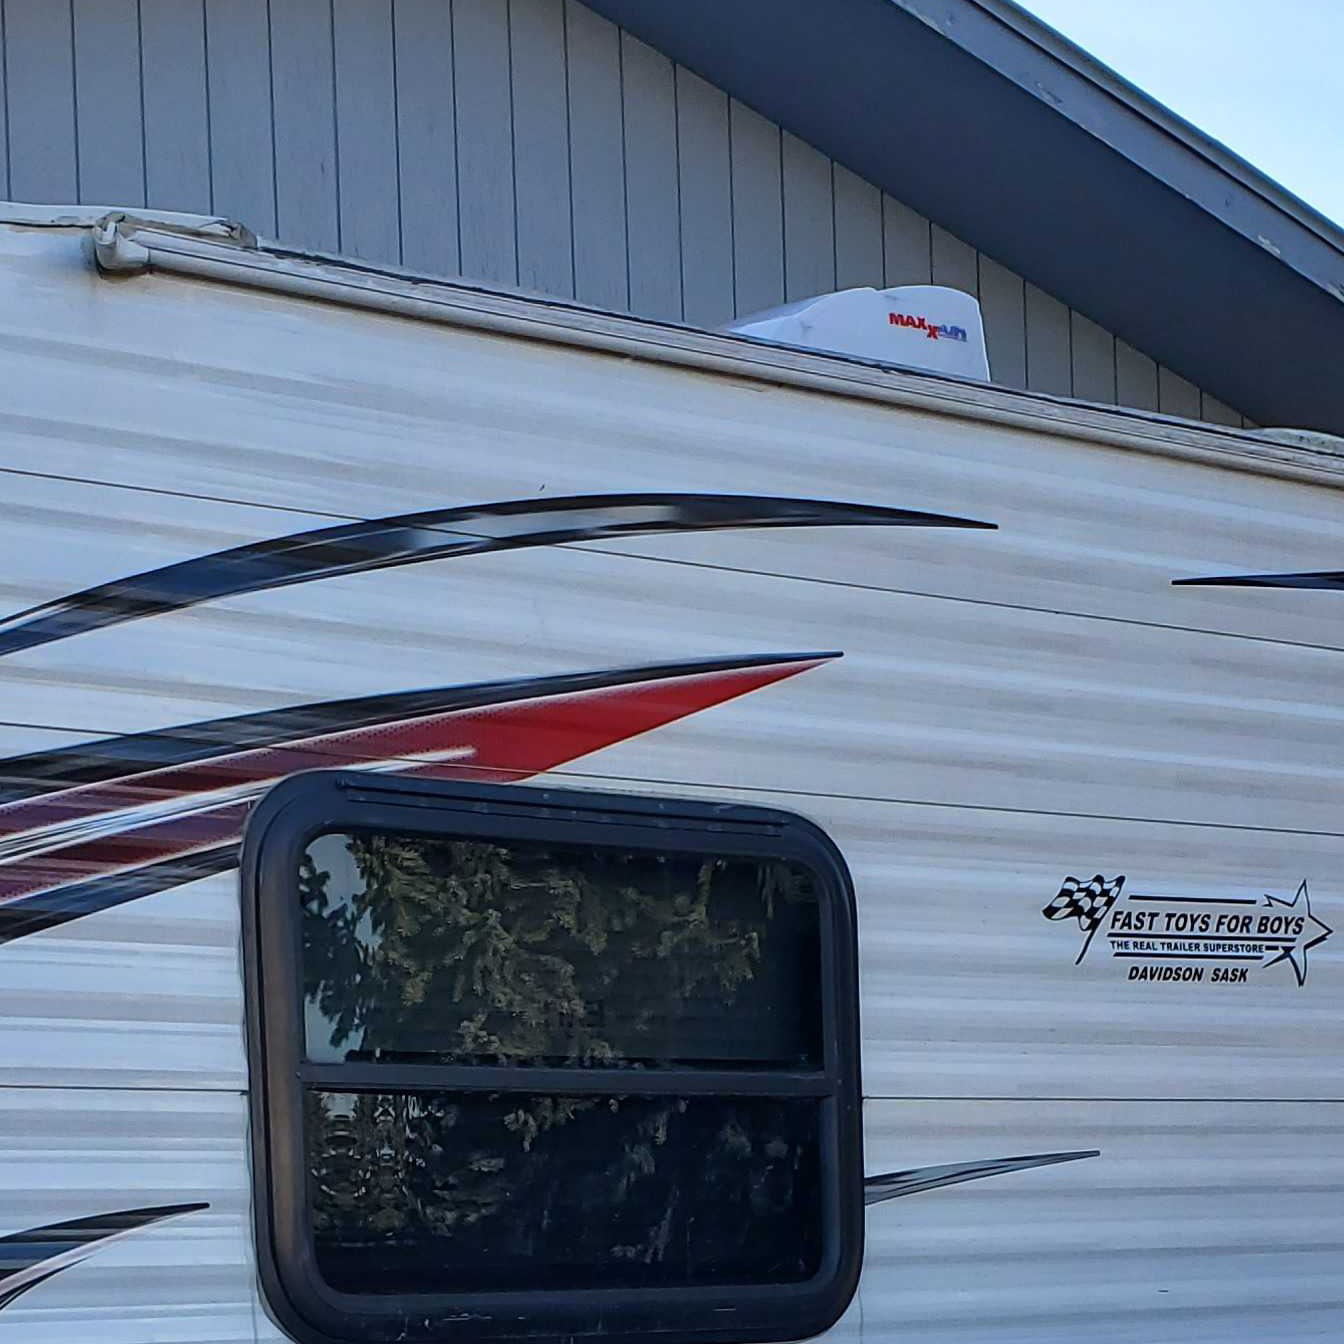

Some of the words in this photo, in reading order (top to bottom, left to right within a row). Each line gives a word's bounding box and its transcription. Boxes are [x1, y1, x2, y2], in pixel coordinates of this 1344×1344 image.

[1110, 911, 1158, 930] FAST
[1165, 913, 1210, 933] TOYS
[1215, 914, 1252, 934] FOR
[1256, 915, 1305, 935] BOYS
[1109, 940, 1130, 951] THE
[1133, 942, 1158, 952] REAL
[1160, 942, 1201, 952] TRAILER
[1203, 943, 1264, 954] SUPERSTORE
[1128, 965, 1203, 982] DAVIDSON
[1211, 968, 1249, 983] SASK
